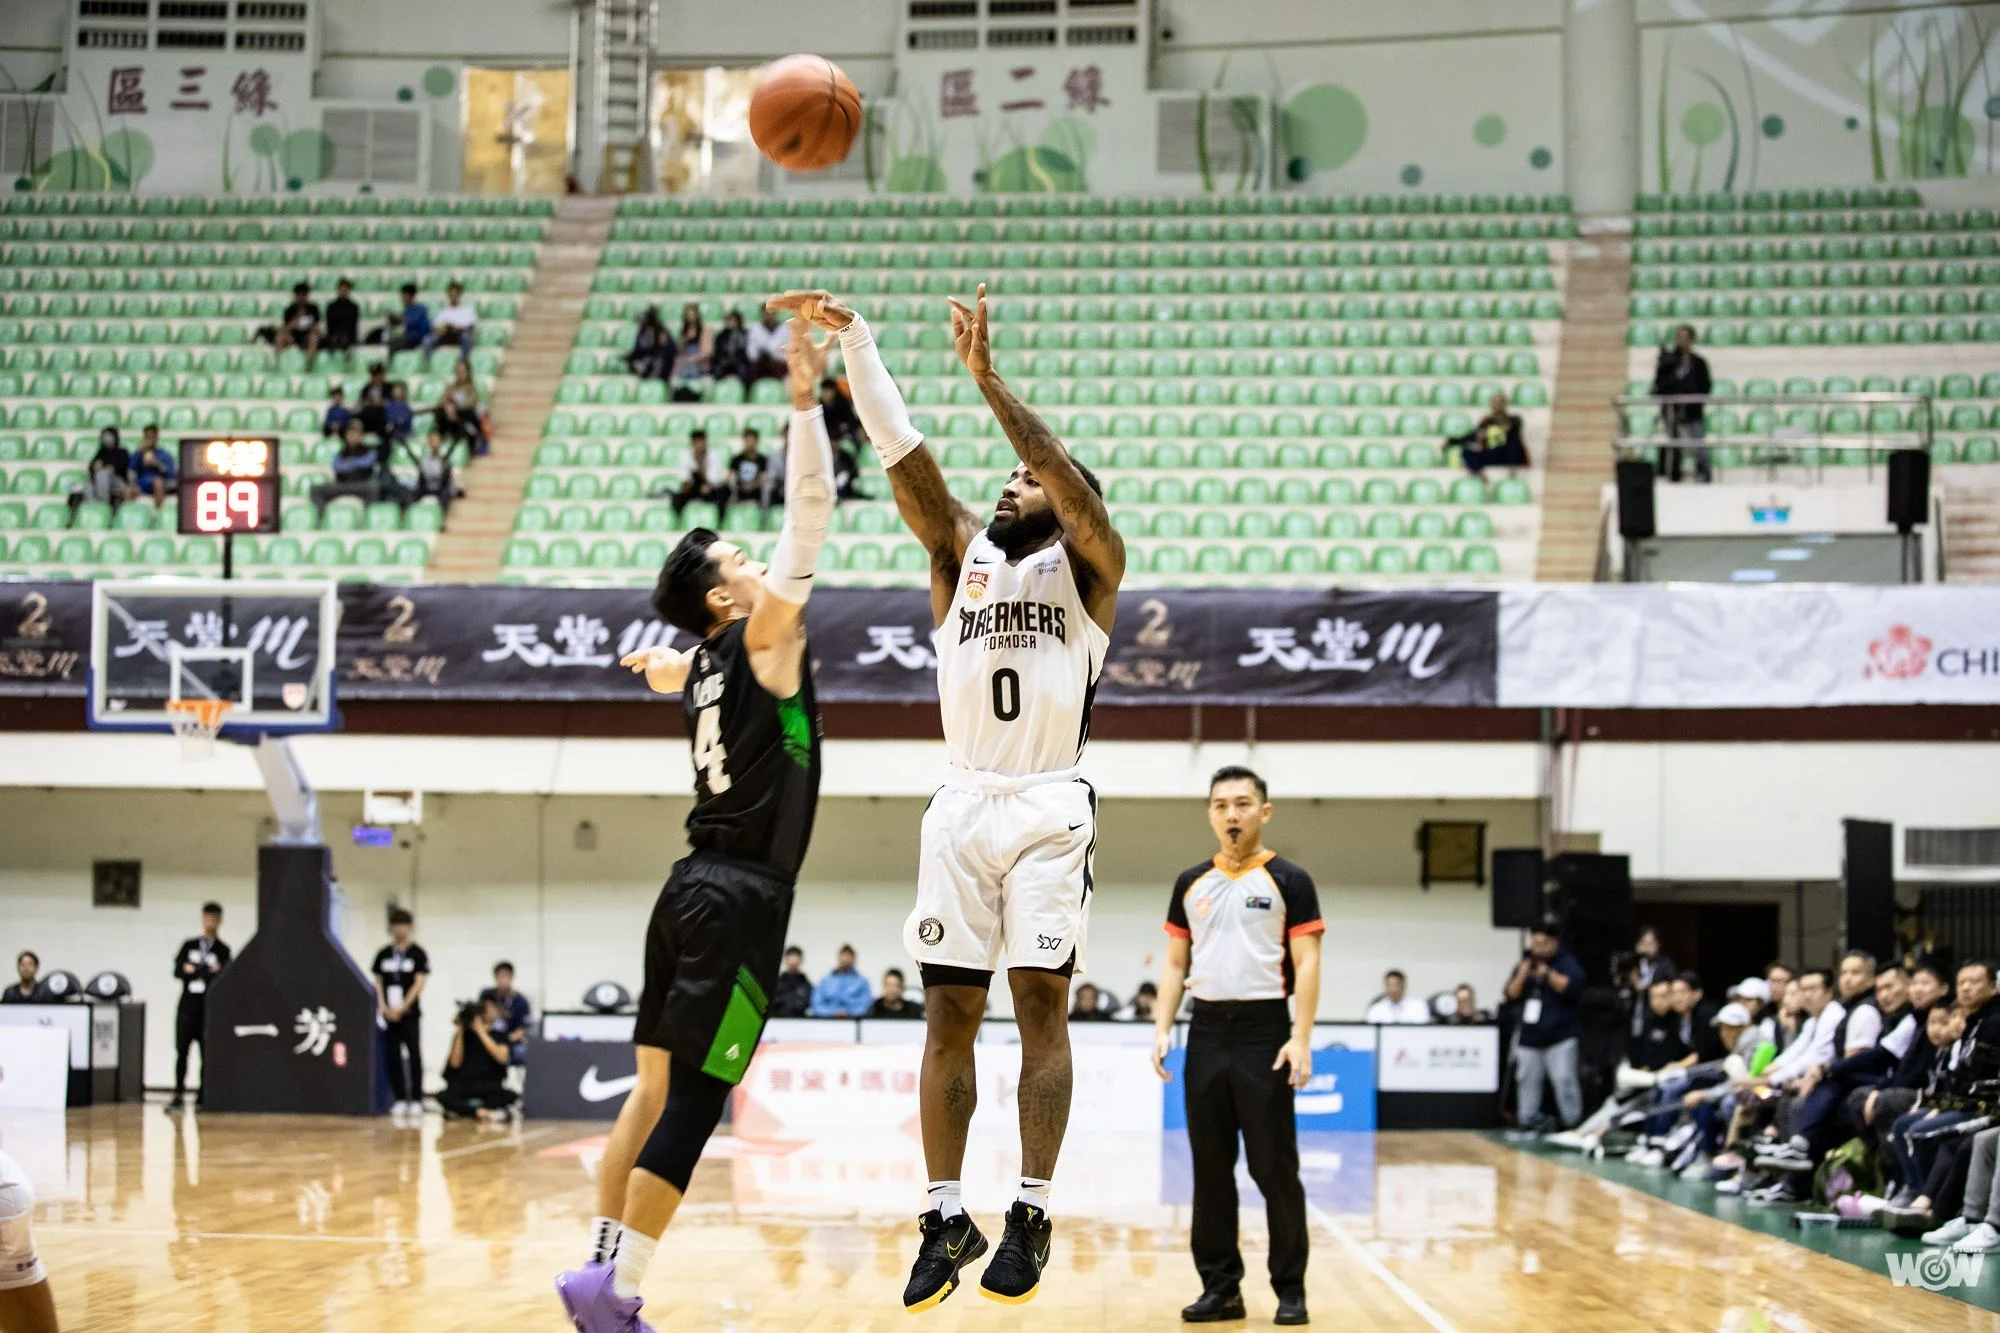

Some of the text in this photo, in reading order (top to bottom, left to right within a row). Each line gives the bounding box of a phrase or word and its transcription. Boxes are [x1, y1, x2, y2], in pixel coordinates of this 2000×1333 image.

[968, 572, 988, 585] ABL
[958, 600, 1067, 647] DREAMERS
[983, 634, 1037, 652] FORMOSA
[992, 667, 1020, 721] 0
[694, 704, 732, 795] 4
[233, 1005, 337, 1057] 一芳
